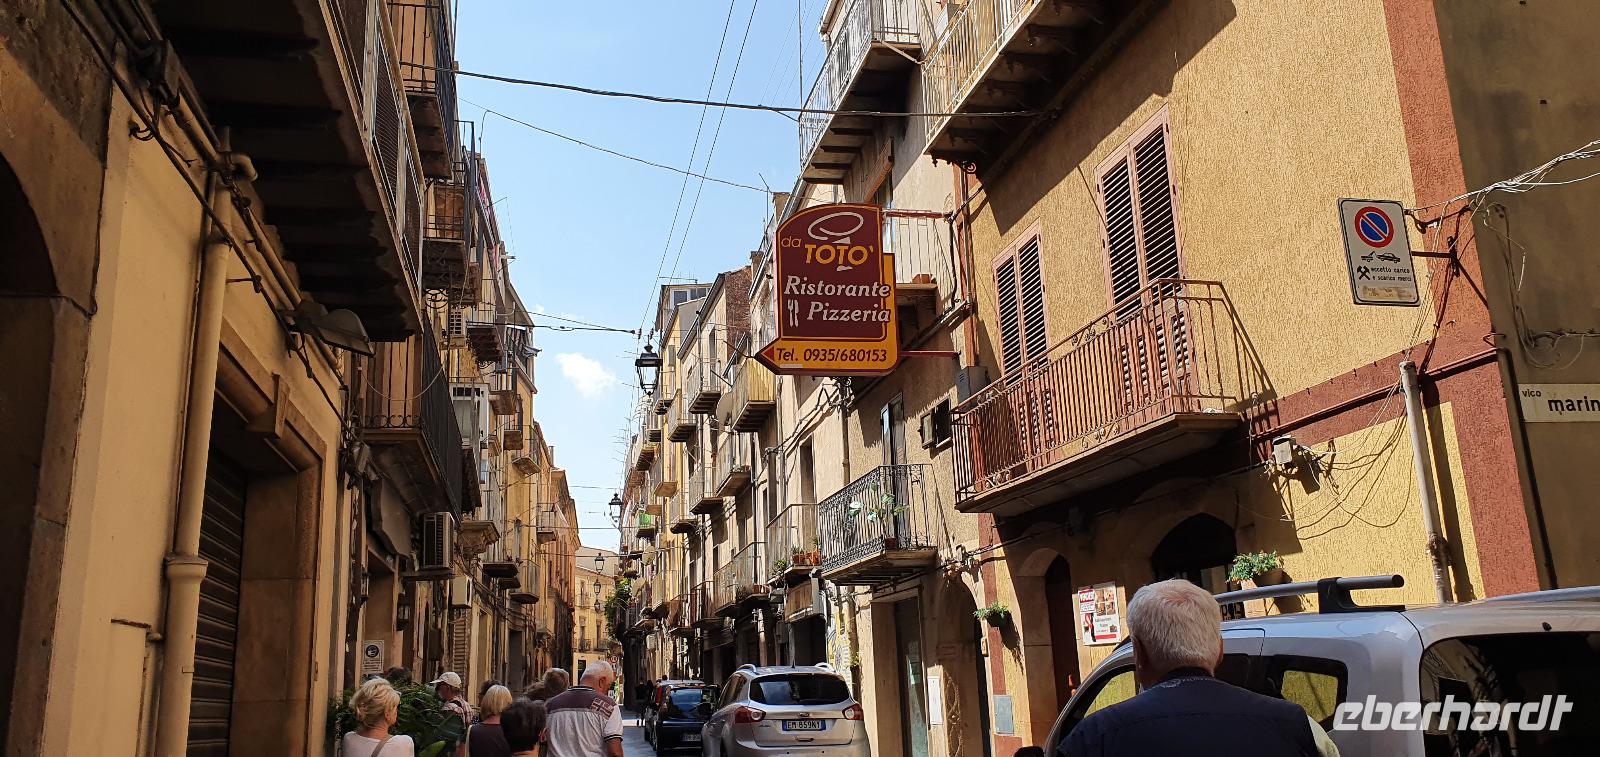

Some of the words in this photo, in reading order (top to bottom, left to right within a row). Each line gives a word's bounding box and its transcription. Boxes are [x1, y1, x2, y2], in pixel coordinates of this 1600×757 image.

[781, 236, 802, 248] da
[784, 275, 891, 297] Ristorante
[807, 301, 891, 322] Pizzeria
[777, 348, 799, 362] Tel.
[803, 348, 887, 362] 0935/680153
[1522, 389, 1542, 397] vico
